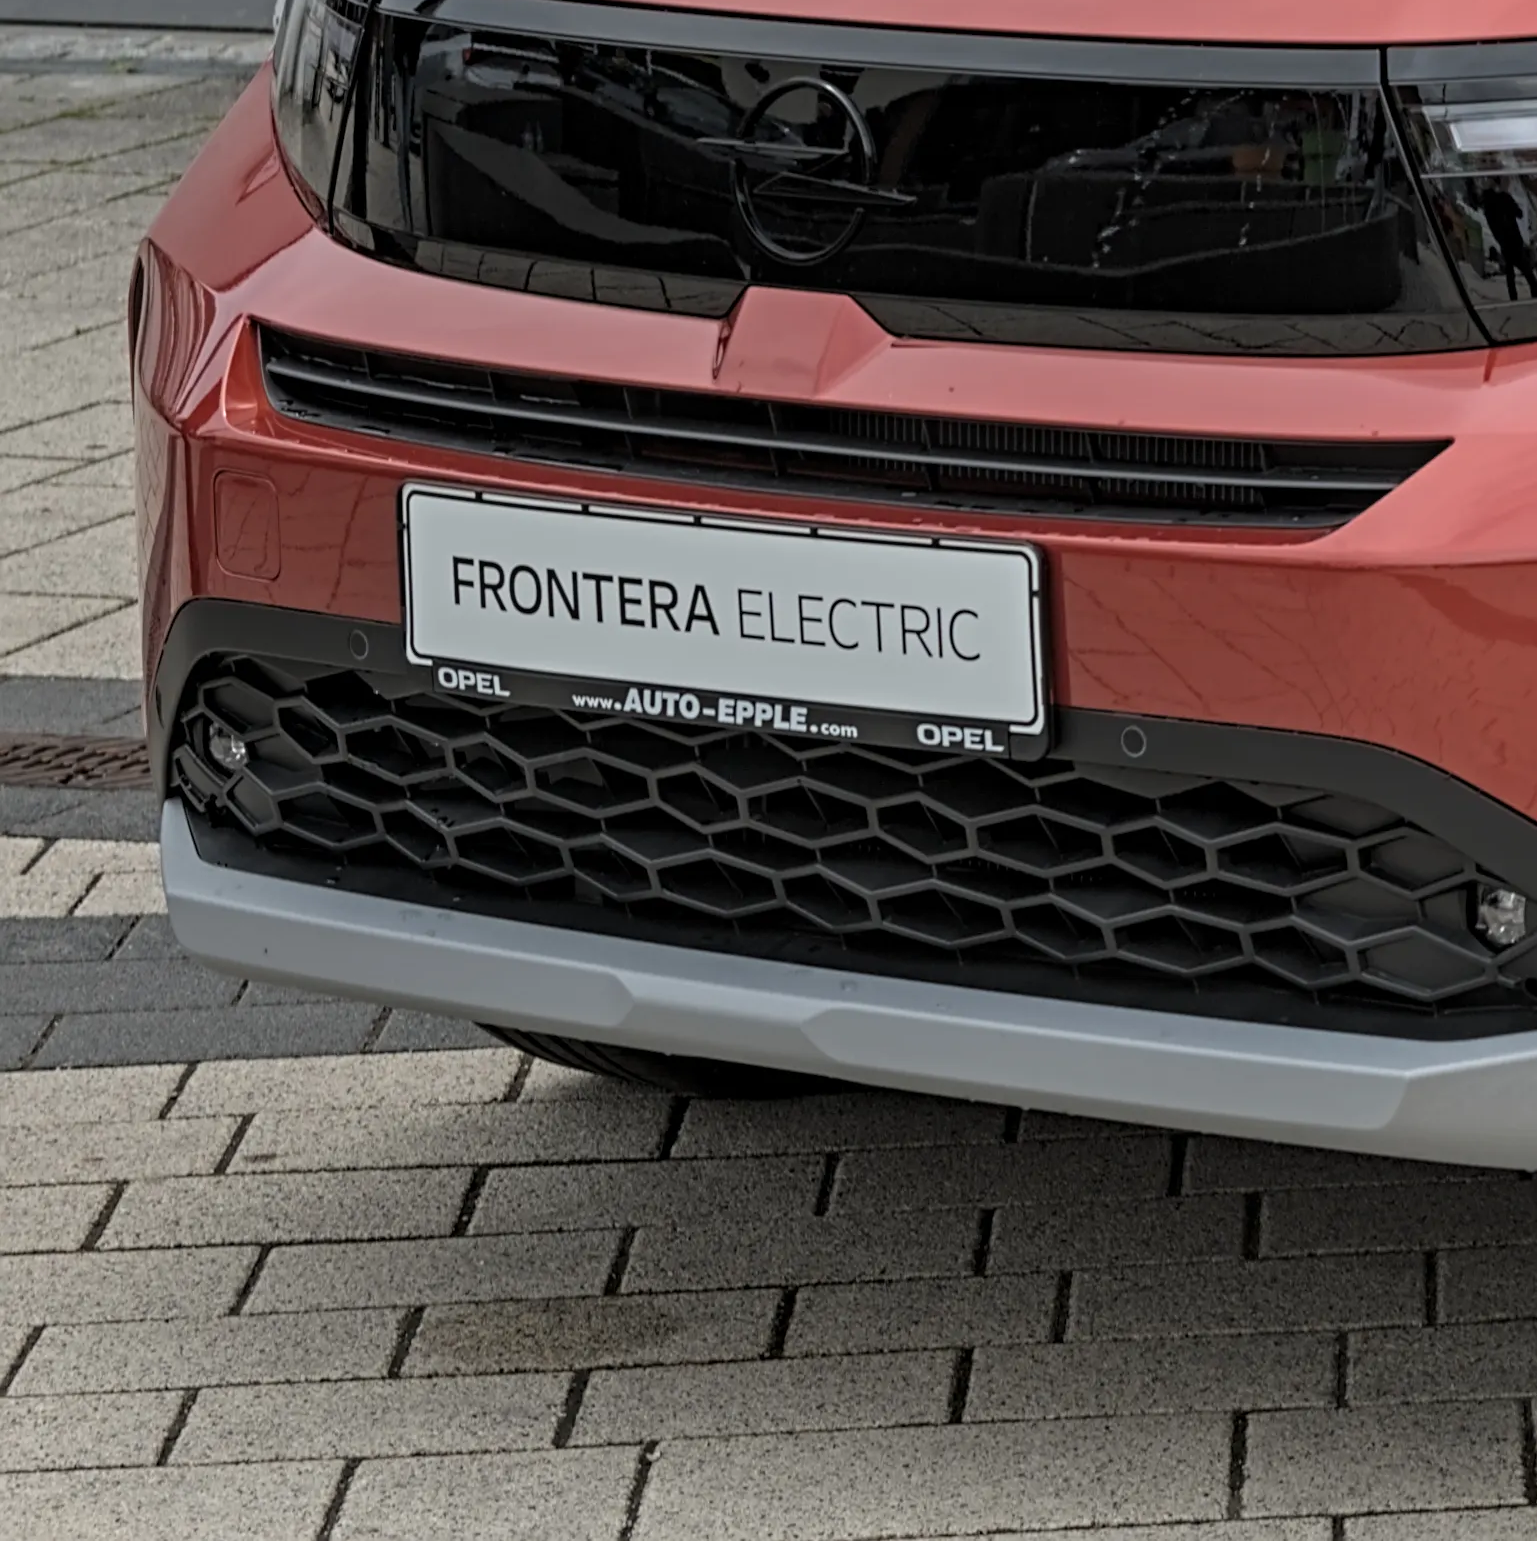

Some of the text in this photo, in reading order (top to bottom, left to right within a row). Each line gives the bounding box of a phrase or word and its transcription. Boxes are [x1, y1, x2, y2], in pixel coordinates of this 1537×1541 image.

[451, 555, 982, 662] FRONTERA ELECTRIC
[437, 665, 1004, 754] OPEL www.AUTO-EPPLE.com OPEL
